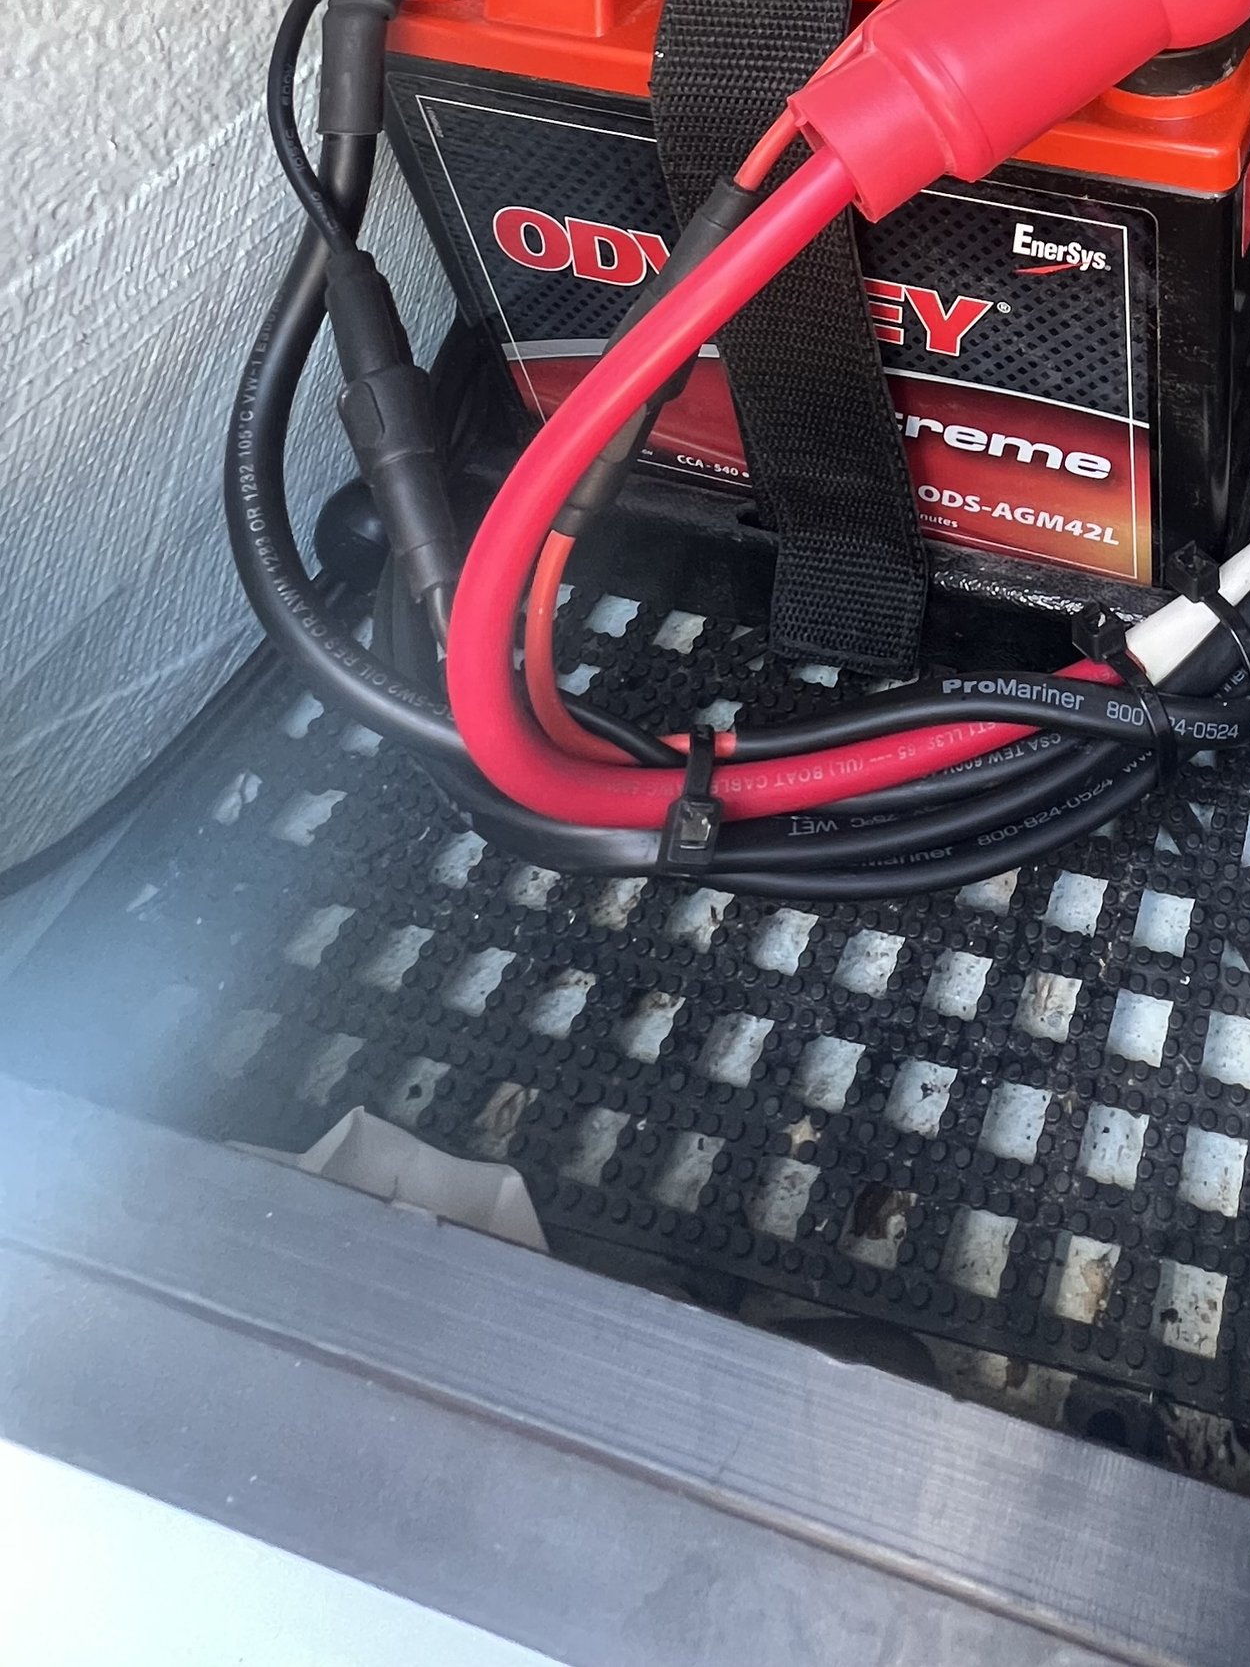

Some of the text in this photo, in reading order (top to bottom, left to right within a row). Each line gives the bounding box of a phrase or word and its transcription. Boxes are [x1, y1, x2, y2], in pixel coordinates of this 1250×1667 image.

[1012, 222, 1108, 272] EnerSys
[242, 358, 263, 406] VW-1
[676, 454, 739, 477] CCA 540
[238, 463, 260, 503] 1232
[246, 505, 266, 533] OR
[917, 484, 1121, 547] ODS-AGM42L
[919, 512, 959, 530] nutes
[273, 575, 310, 614] AWM
[301, 615, 328, 638] OR
[359, 662, 388, 686] OIL
[941, 677, 1085, 711] ProMariner
[988, 746, 1025, 765] TEW
[1031, 732, 1062, 752] CSA
[710, 755, 865, 795] (UL) BOAT CABLE
[787, 815, 838, 837] WET
[976, 776, 1115, 847] 800-824-0524
